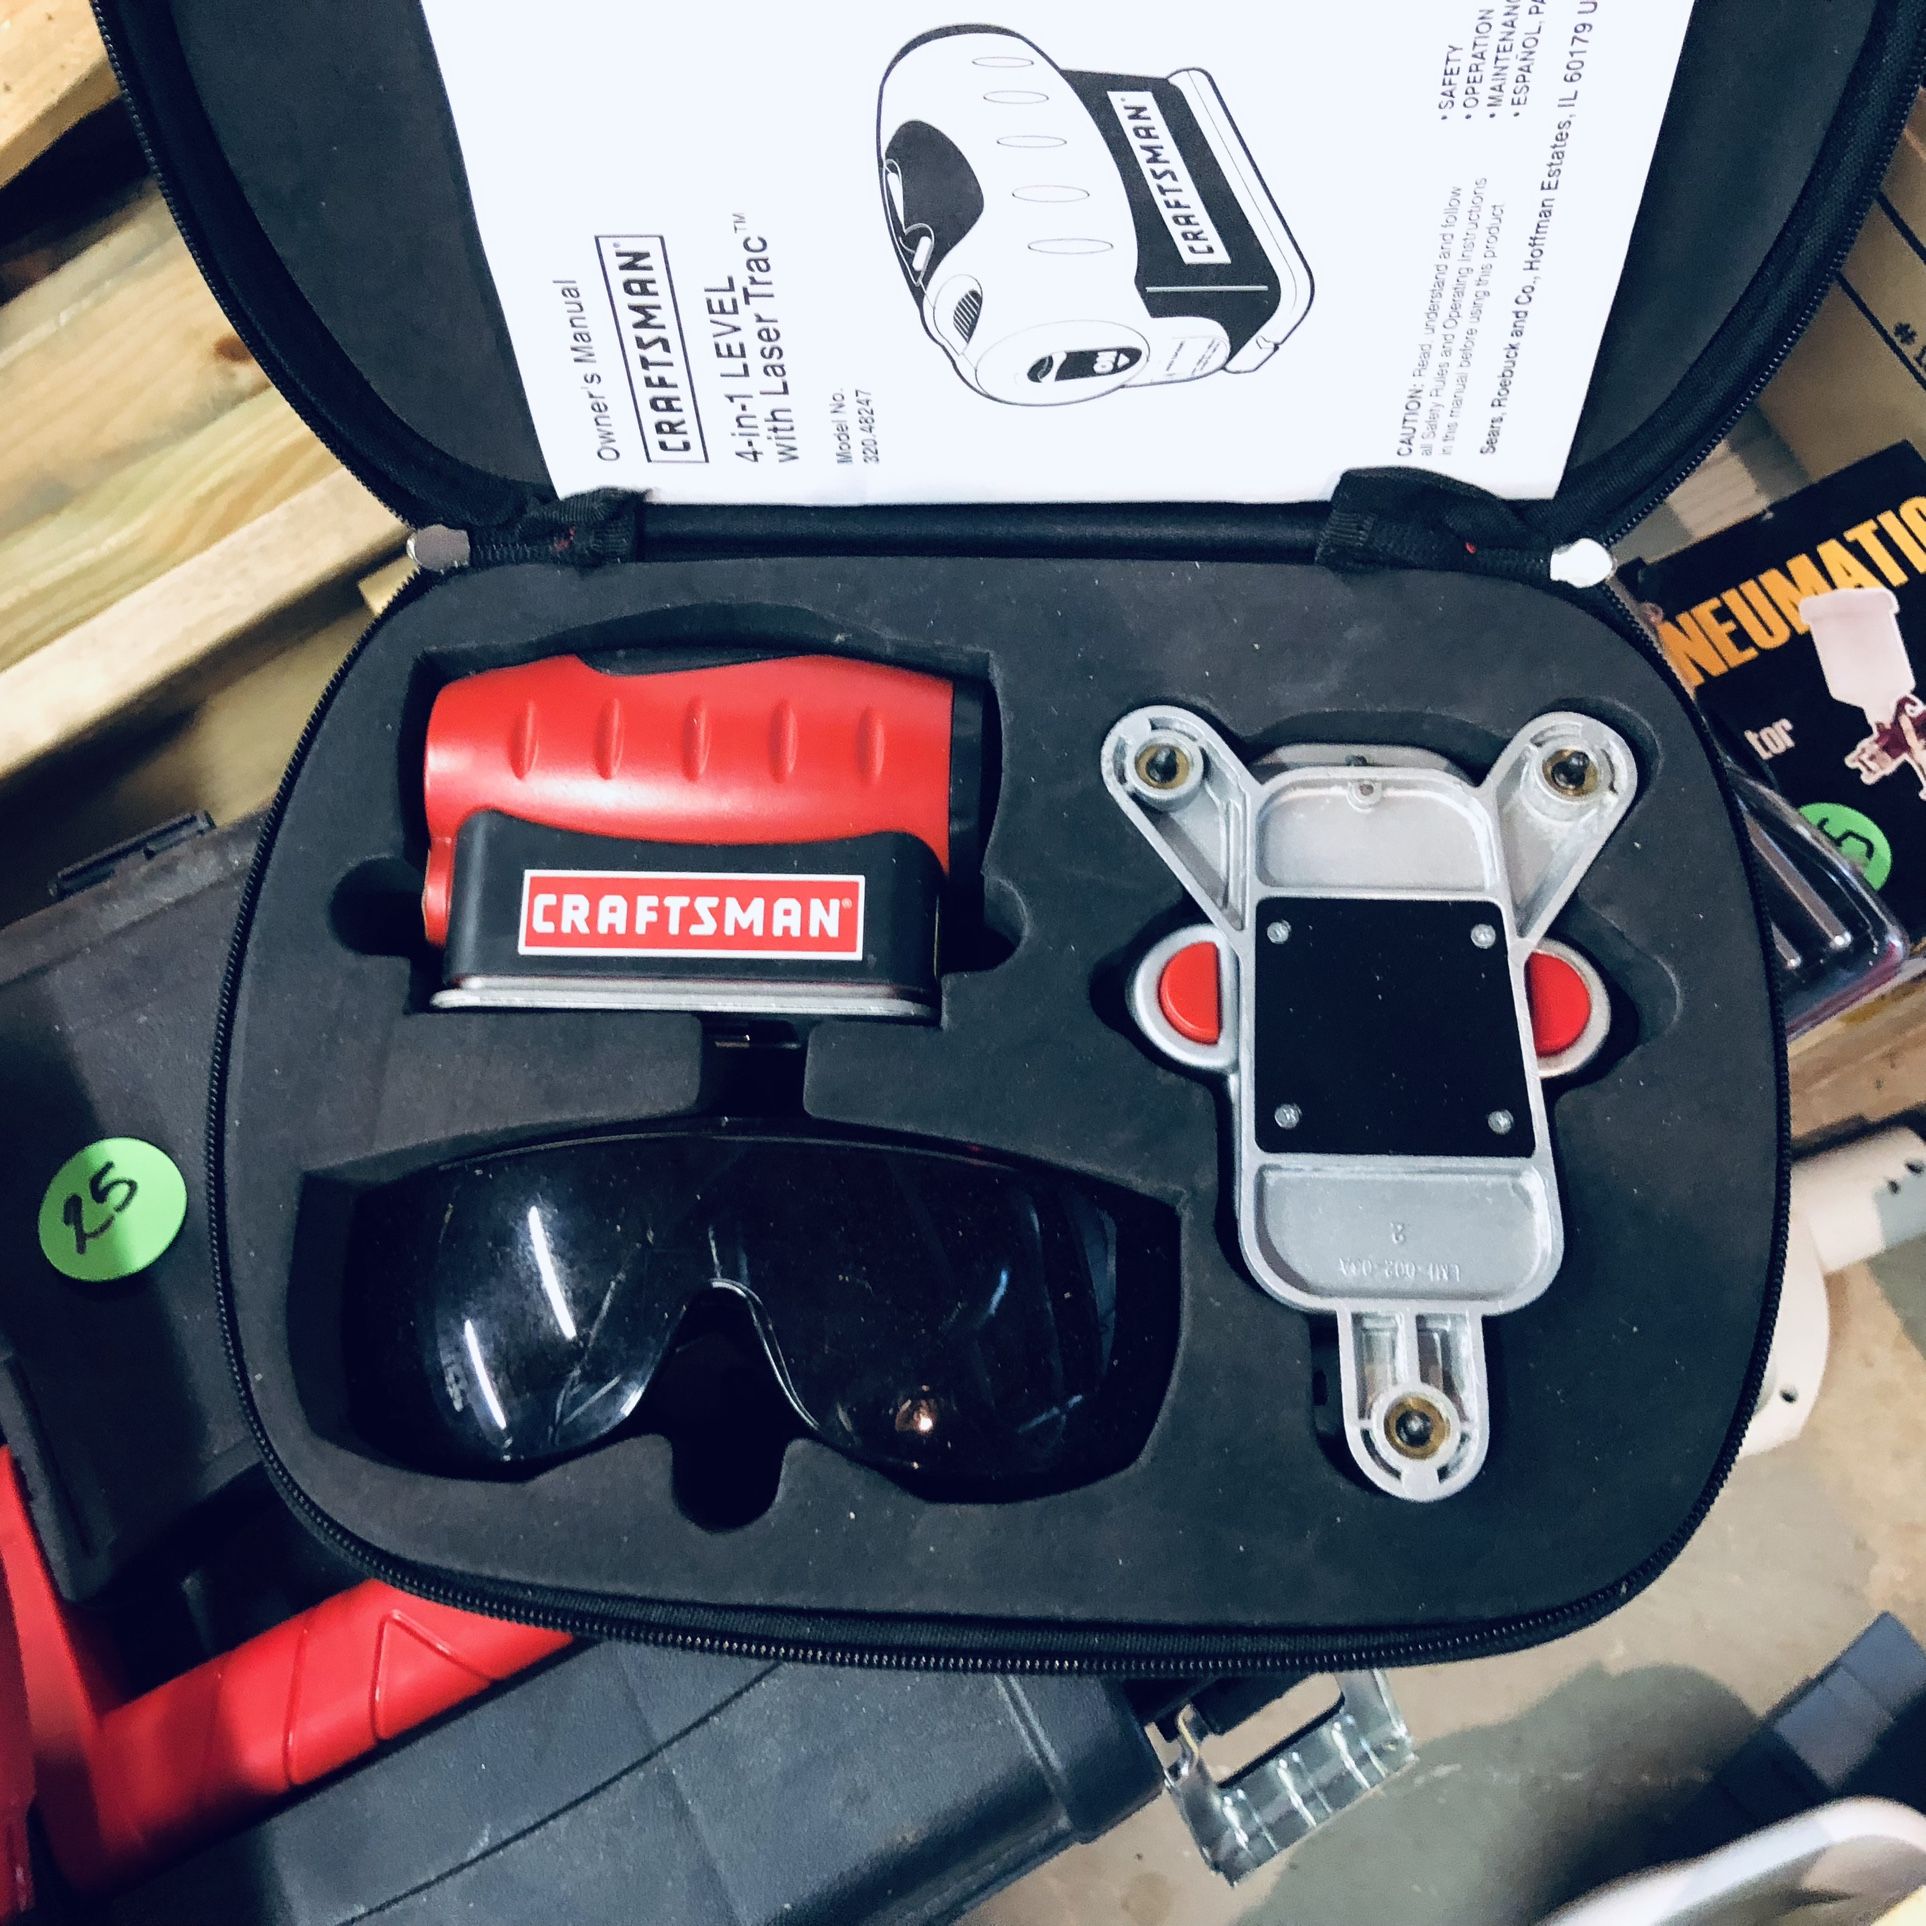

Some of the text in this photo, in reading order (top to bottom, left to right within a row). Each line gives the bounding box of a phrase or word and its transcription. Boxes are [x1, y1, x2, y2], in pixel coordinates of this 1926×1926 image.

[1438, 44, 1463, 110] SAFETY
[1463, 8, 1494, 109] OPERATION
[1487, 0, 1520, 108] MAINTENAN
[1563, 23, 1593, 83] 60179
[1557, 90, 1578, 108] IL
[1540, 113, 1576, 191] Estates,
[1441, 186, 1461, 228] follow
[1522, 198, 1555, 271] Hoffman
[1439, 232, 1454, 259] and
[1475, 263, 1493, 287] this
[1420, 177, 1487, 456] all Safety Rules and Operating Instructions
[1424, 264, 1448, 335] understand
[1469, 290, 1490, 324] using
[1511, 310, 1528, 337] and
[553, 280, 620, 462] Owner's Manual
[704, 275, 763, 463] 4-in-1 LEVEL
[754, 313, 789, 396] Laser
[1459, 328, 1478, 368] before
[1491, 342, 1520, 408] Roebuck
[829, 387, 853, 464] Model No.
[855, 388, 880, 463] 320.48247
[1396, 384, 1424, 456] CAUTION:
[1449, 372, 1468, 418] manual
[764, 408, 799, 463] with
[1441, 445, 1453, 455] in
[1442, 421, 1458, 442] this
[1480, 412, 1507, 454] Sears,
[532, 893, 840, 938] CRAFTSMAN
[62, 1160, 138, 1255] 25
